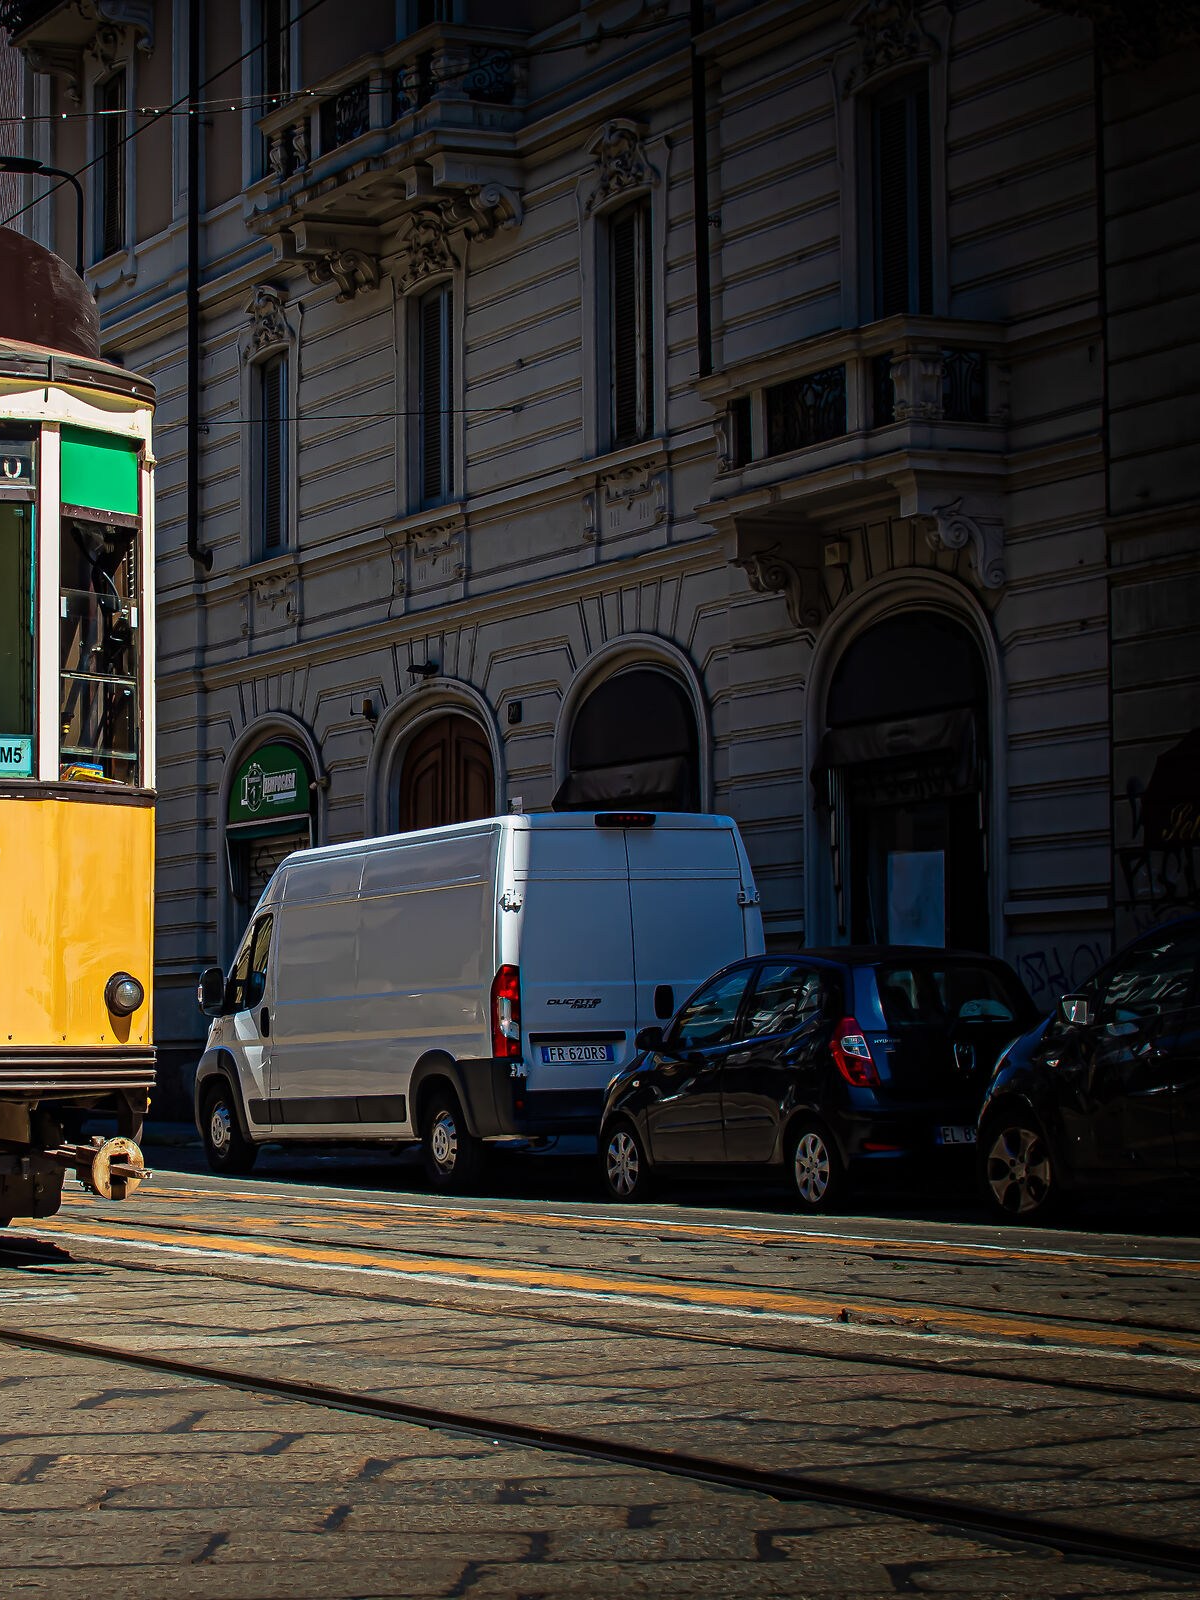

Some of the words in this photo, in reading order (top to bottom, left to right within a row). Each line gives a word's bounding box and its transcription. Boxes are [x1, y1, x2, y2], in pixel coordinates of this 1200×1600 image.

[0, 746, 22, 764] M5
[546, 998, 602, 1006] DUCATO
[549, 1046, 566, 1061] FR
[569, 1046, 606, 1061] 620RS
[942, 1127, 961, 1143] EL
